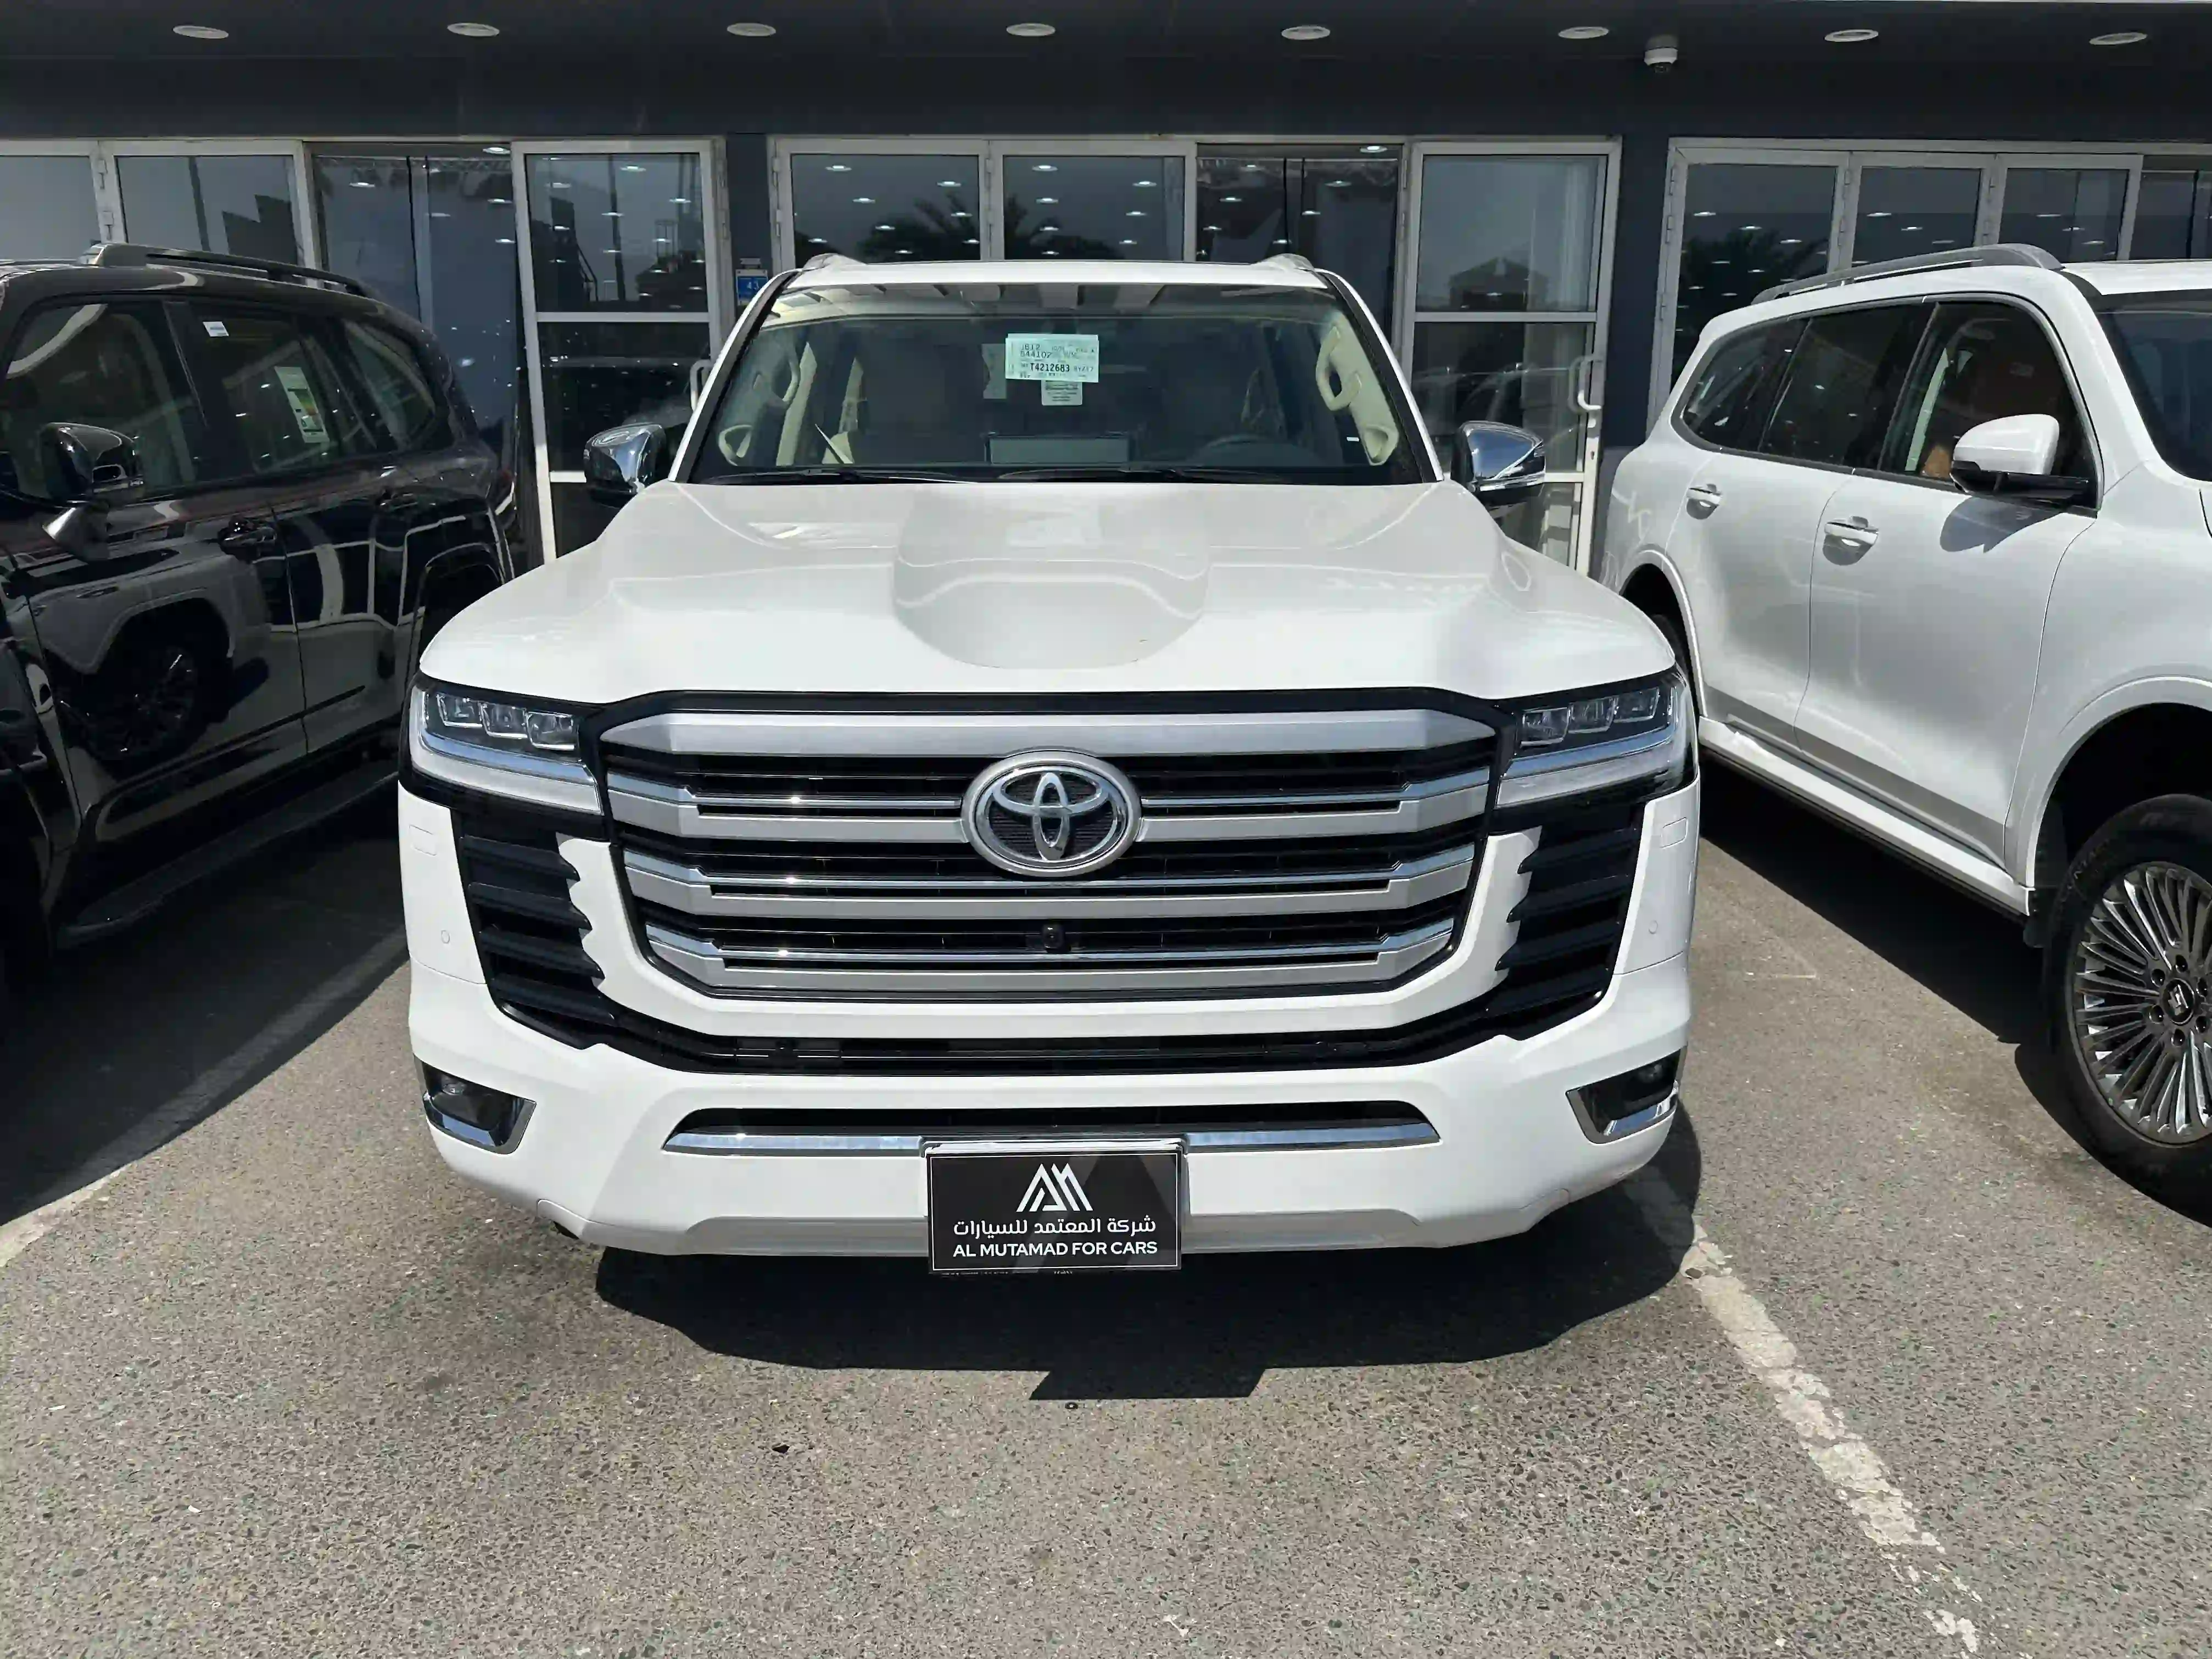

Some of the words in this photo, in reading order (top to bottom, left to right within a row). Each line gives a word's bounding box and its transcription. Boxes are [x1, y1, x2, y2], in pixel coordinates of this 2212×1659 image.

[1030, 362, 1070, 372] T4212683
[953, 1219, 1027, 1239] للسيارات
[1034, 1218, 1101, 1235] المعتمد
[1107, 1215, 1156, 1237] شركة
[953, 1244, 976, 1257] AL
[980, 1243, 1068, 1256] MUTAMAD
[1072, 1242, 1107, 1255] FOR
[1110, 1241, 1158, 1254] CARS
